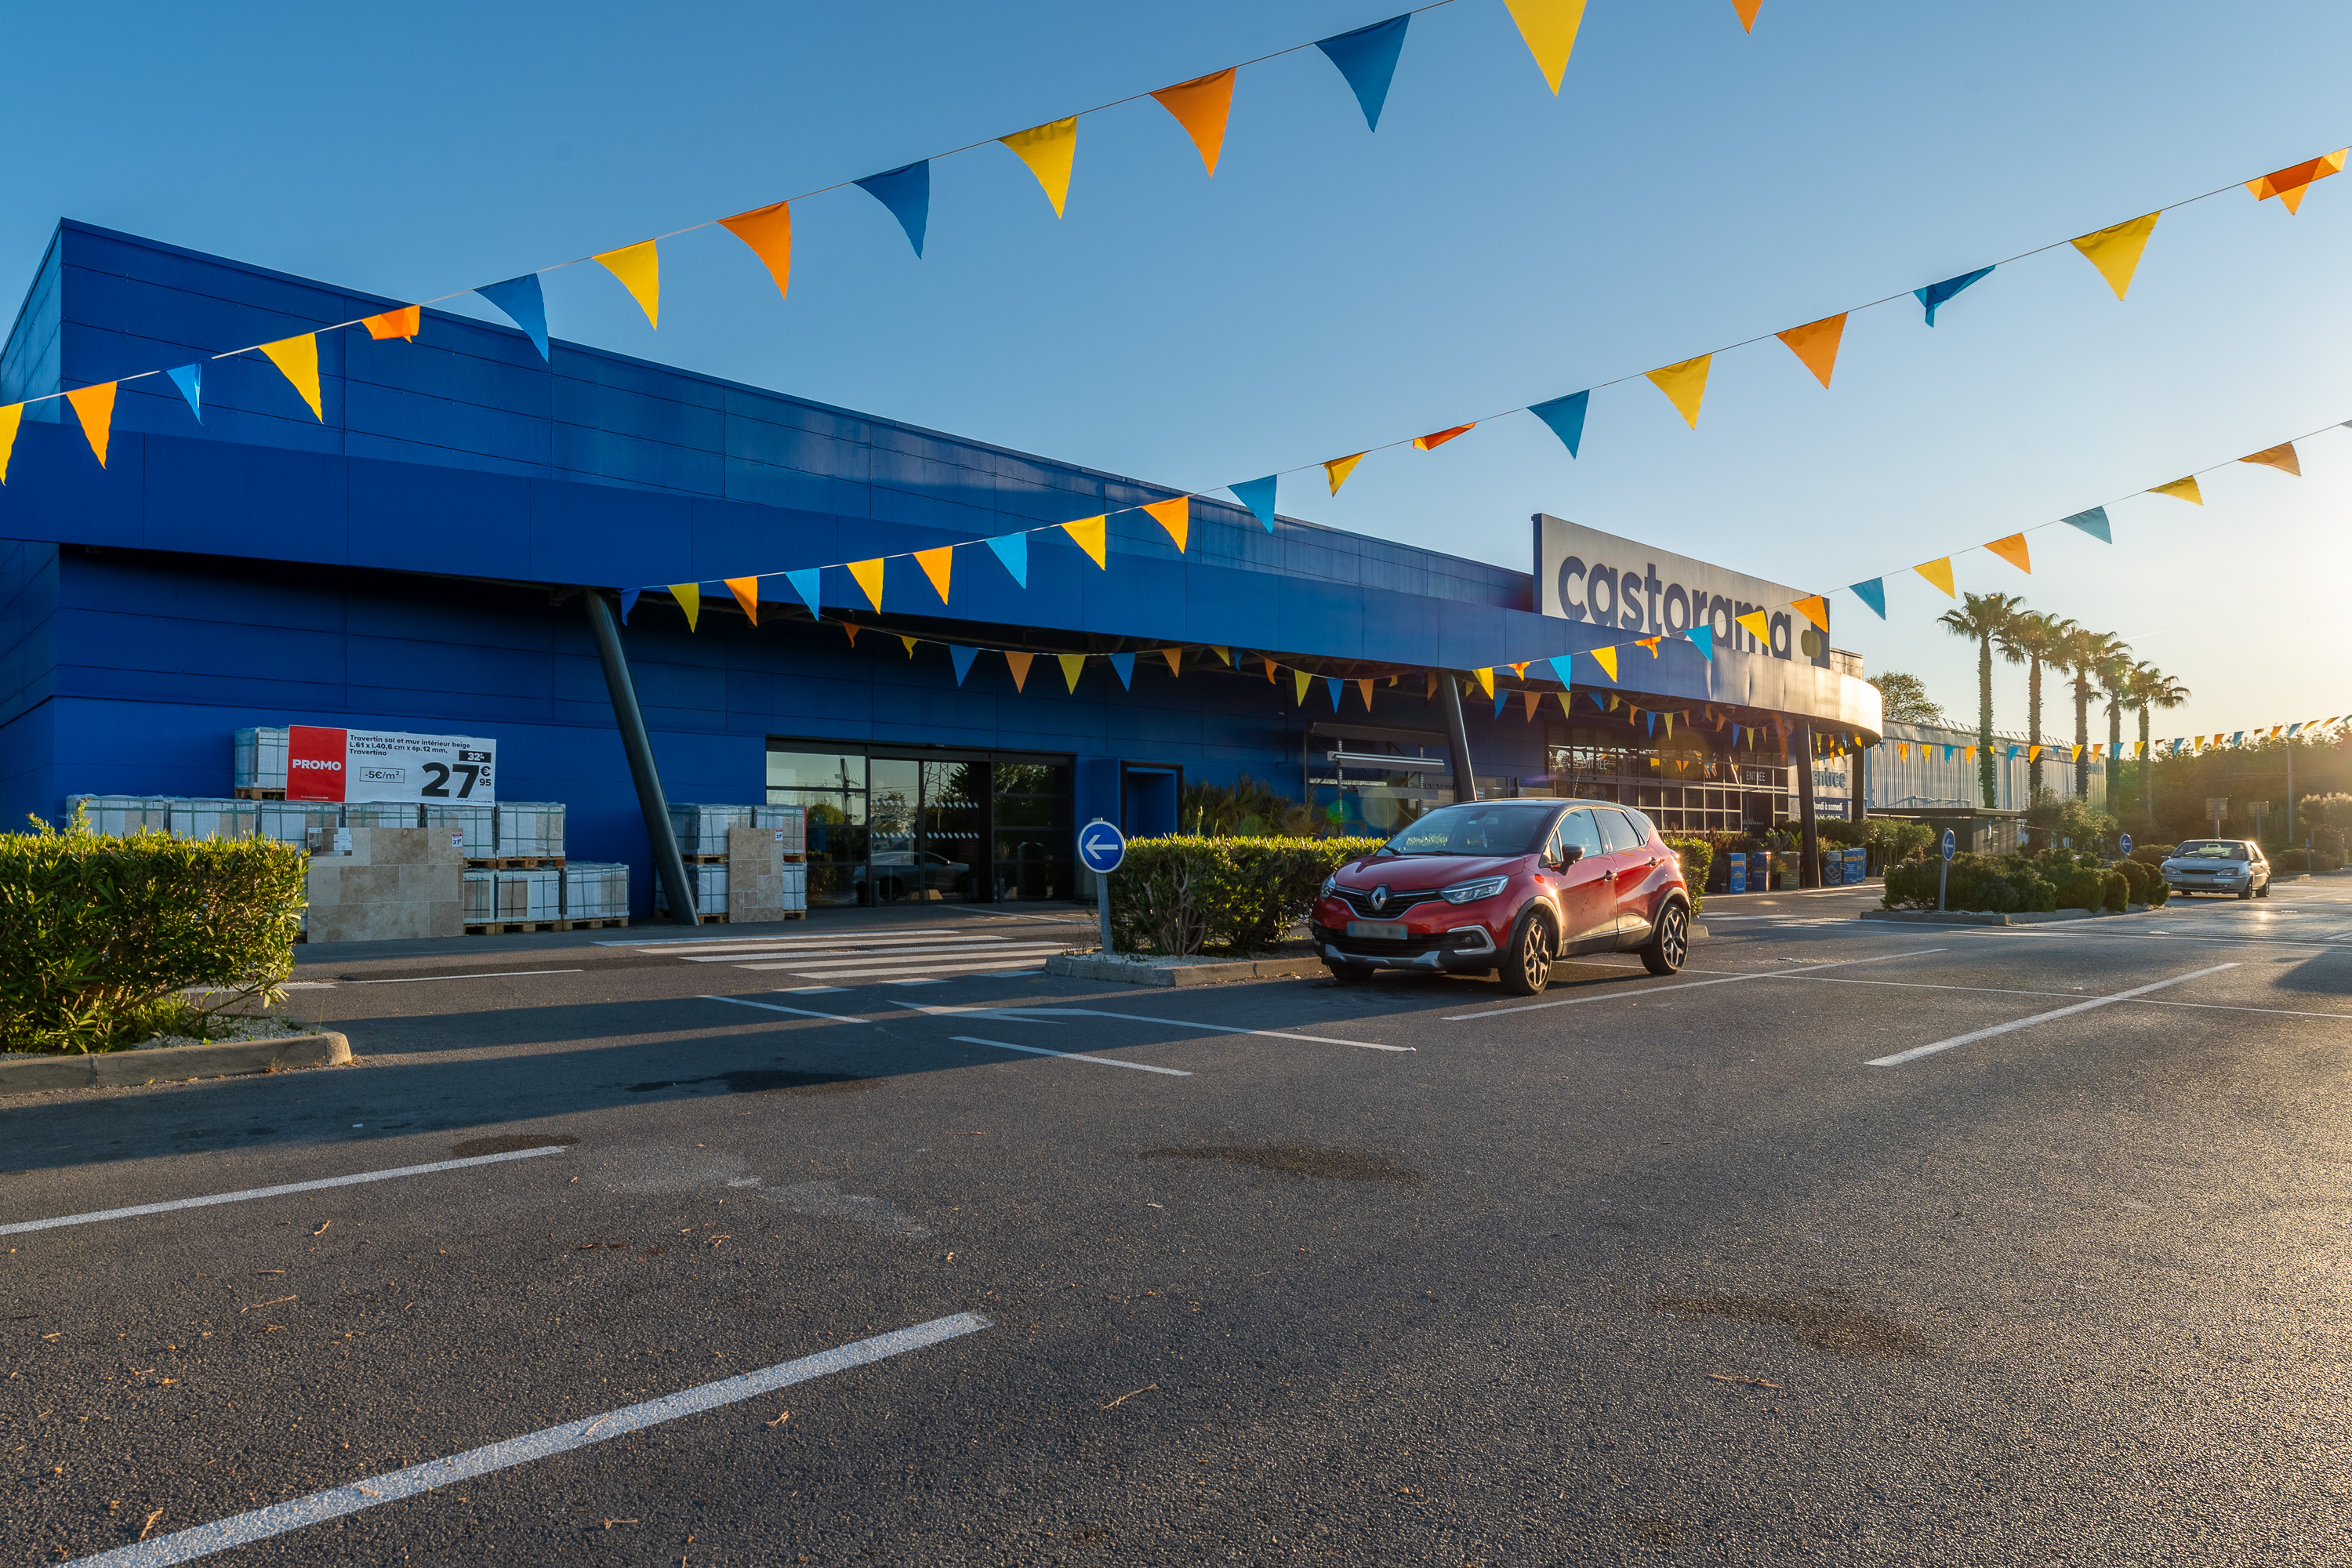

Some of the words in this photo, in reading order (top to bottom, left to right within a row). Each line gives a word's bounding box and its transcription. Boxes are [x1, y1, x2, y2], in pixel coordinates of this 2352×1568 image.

[1558, 555, 1791, 660] castorama
[350, 735, 383, 743] Travertin
[421, 739, 450, 747] intérieur
[452, 741, 471, 750] beige
[350, 748, 387, 757] Travertino
[292, 758, 342, 771] PROMO
